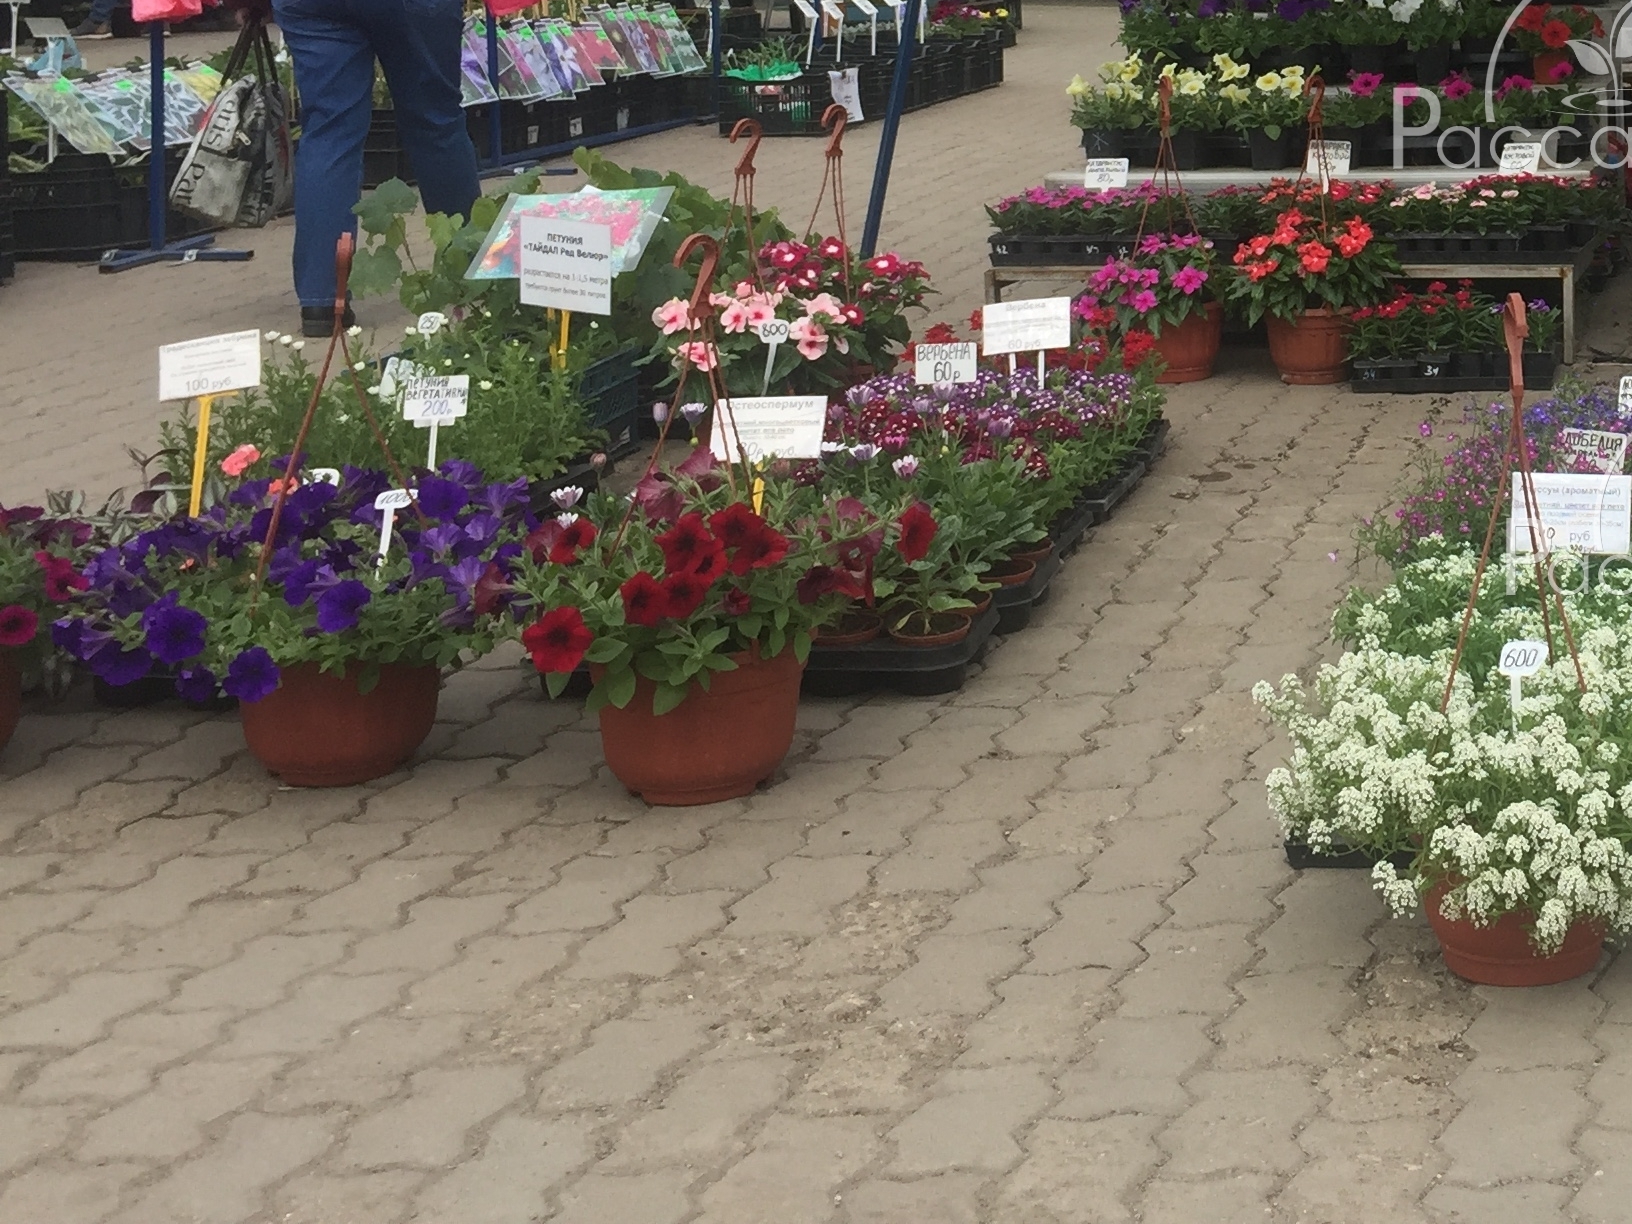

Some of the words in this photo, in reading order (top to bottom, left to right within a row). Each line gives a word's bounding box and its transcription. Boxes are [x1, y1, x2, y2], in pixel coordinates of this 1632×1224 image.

[762, 323, 789, 337] 800
[186, 377, 209, 392] 100
[1504, 648, 1538, 668] 600
